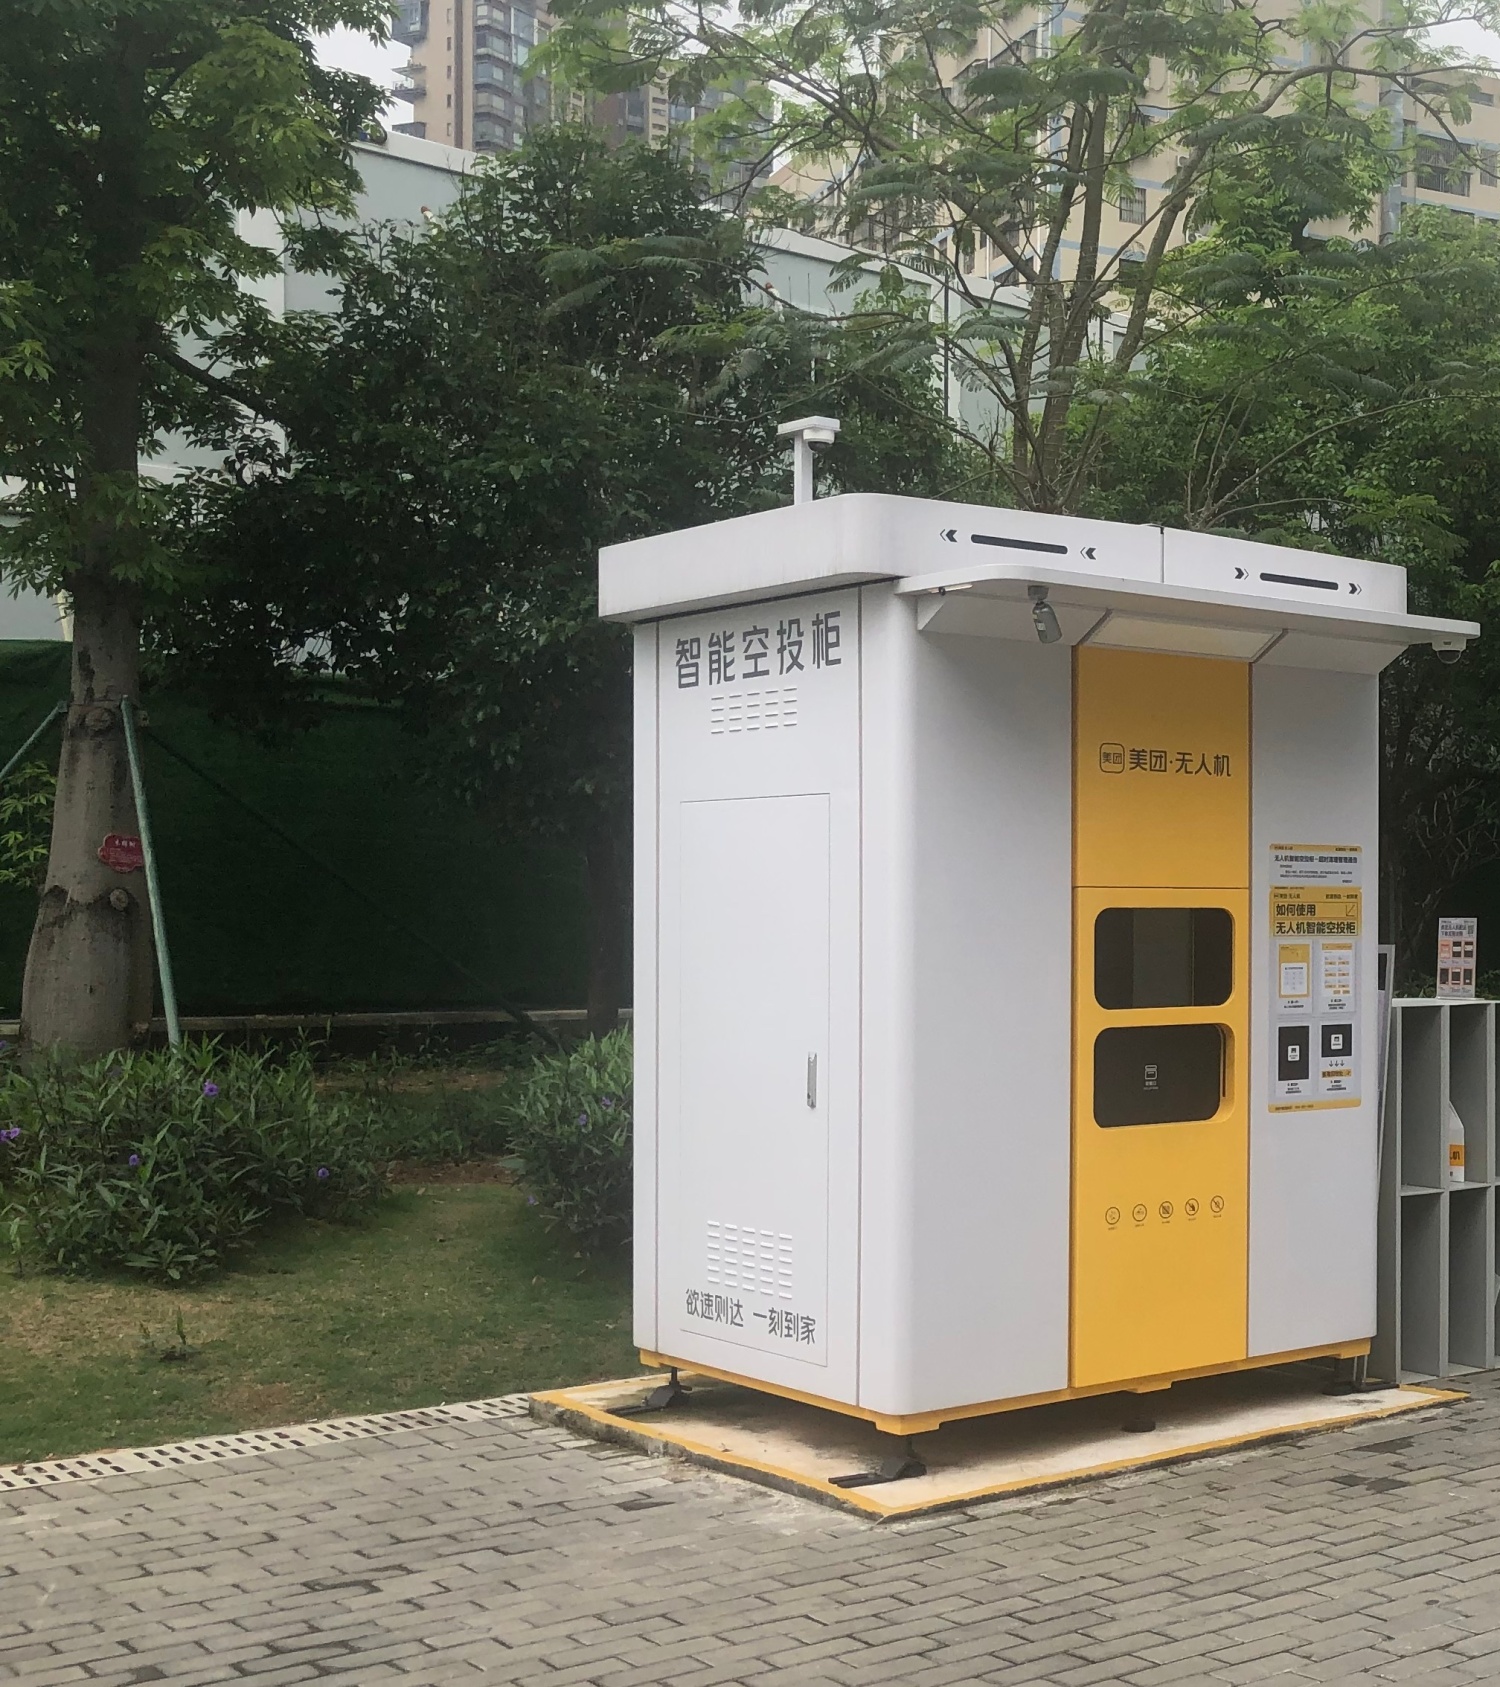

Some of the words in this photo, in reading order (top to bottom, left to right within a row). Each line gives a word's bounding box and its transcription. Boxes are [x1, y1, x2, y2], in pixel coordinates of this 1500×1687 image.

[675, 610, 842, 689] 智能空投柜
[1102, 751, 1123, 765] 美团
[1129, 748, 1232, 777] 美团·无人机
[1276, 904, 1316, 916] 如何使用
[1276, 922, 1356, 934] 无人机智能空投柜
[685, 1288, 744, 1328] 欲速则达
[752, 1307, 816, 1345] 一刻到家
